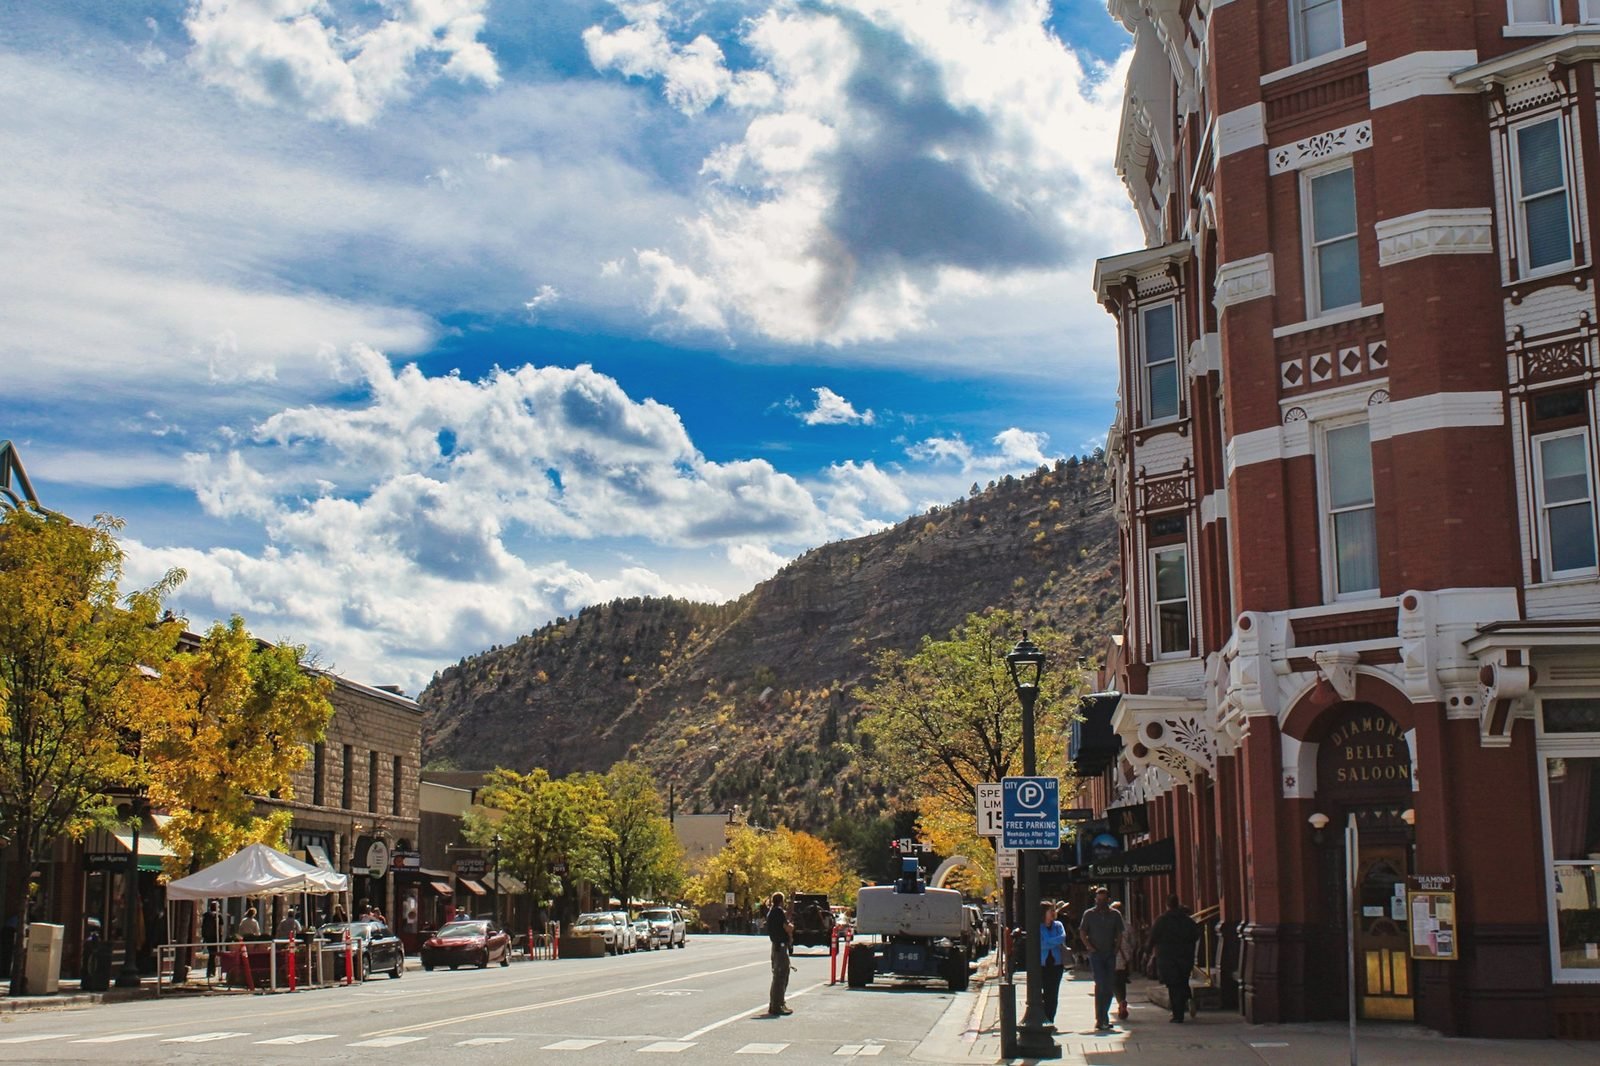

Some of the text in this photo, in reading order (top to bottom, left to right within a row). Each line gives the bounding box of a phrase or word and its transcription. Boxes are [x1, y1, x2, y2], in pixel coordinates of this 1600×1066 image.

[1346, 744, 1394, 760] BELLE
[1337, 765, 1408, 781] SALOON
[980, 789, 1001, 797] SPE
[1025, 787, 1037, 802] P
[984, 800, 1001, 808] LIM
[1006, 821, 1056, 829] FREE PARKING
[1097, 865, 1122, 874] Spirits
[1123, 864, 1130, 873] &
[1131, 863, 1172, 873] Appetizers
